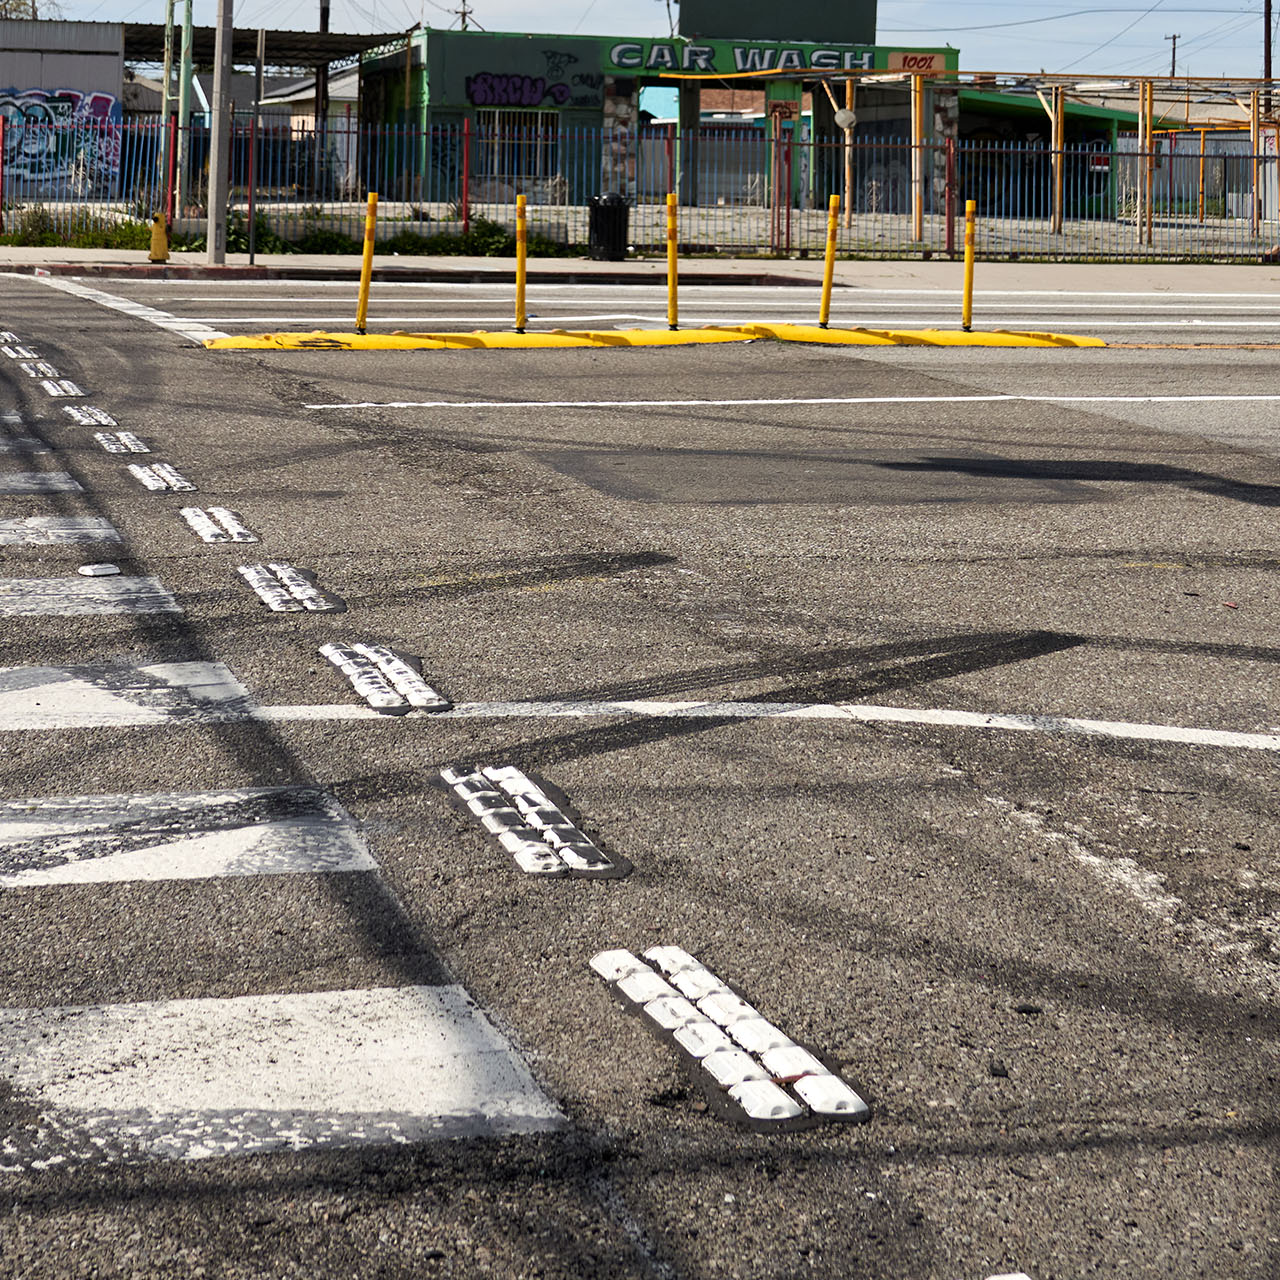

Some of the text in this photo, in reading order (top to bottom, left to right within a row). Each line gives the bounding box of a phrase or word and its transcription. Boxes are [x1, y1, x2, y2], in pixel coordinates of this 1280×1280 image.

[610, 43, 716, 70] CAR
[733, 46, 876, 71] WASH
[902, 55, 935, 70] 100%
